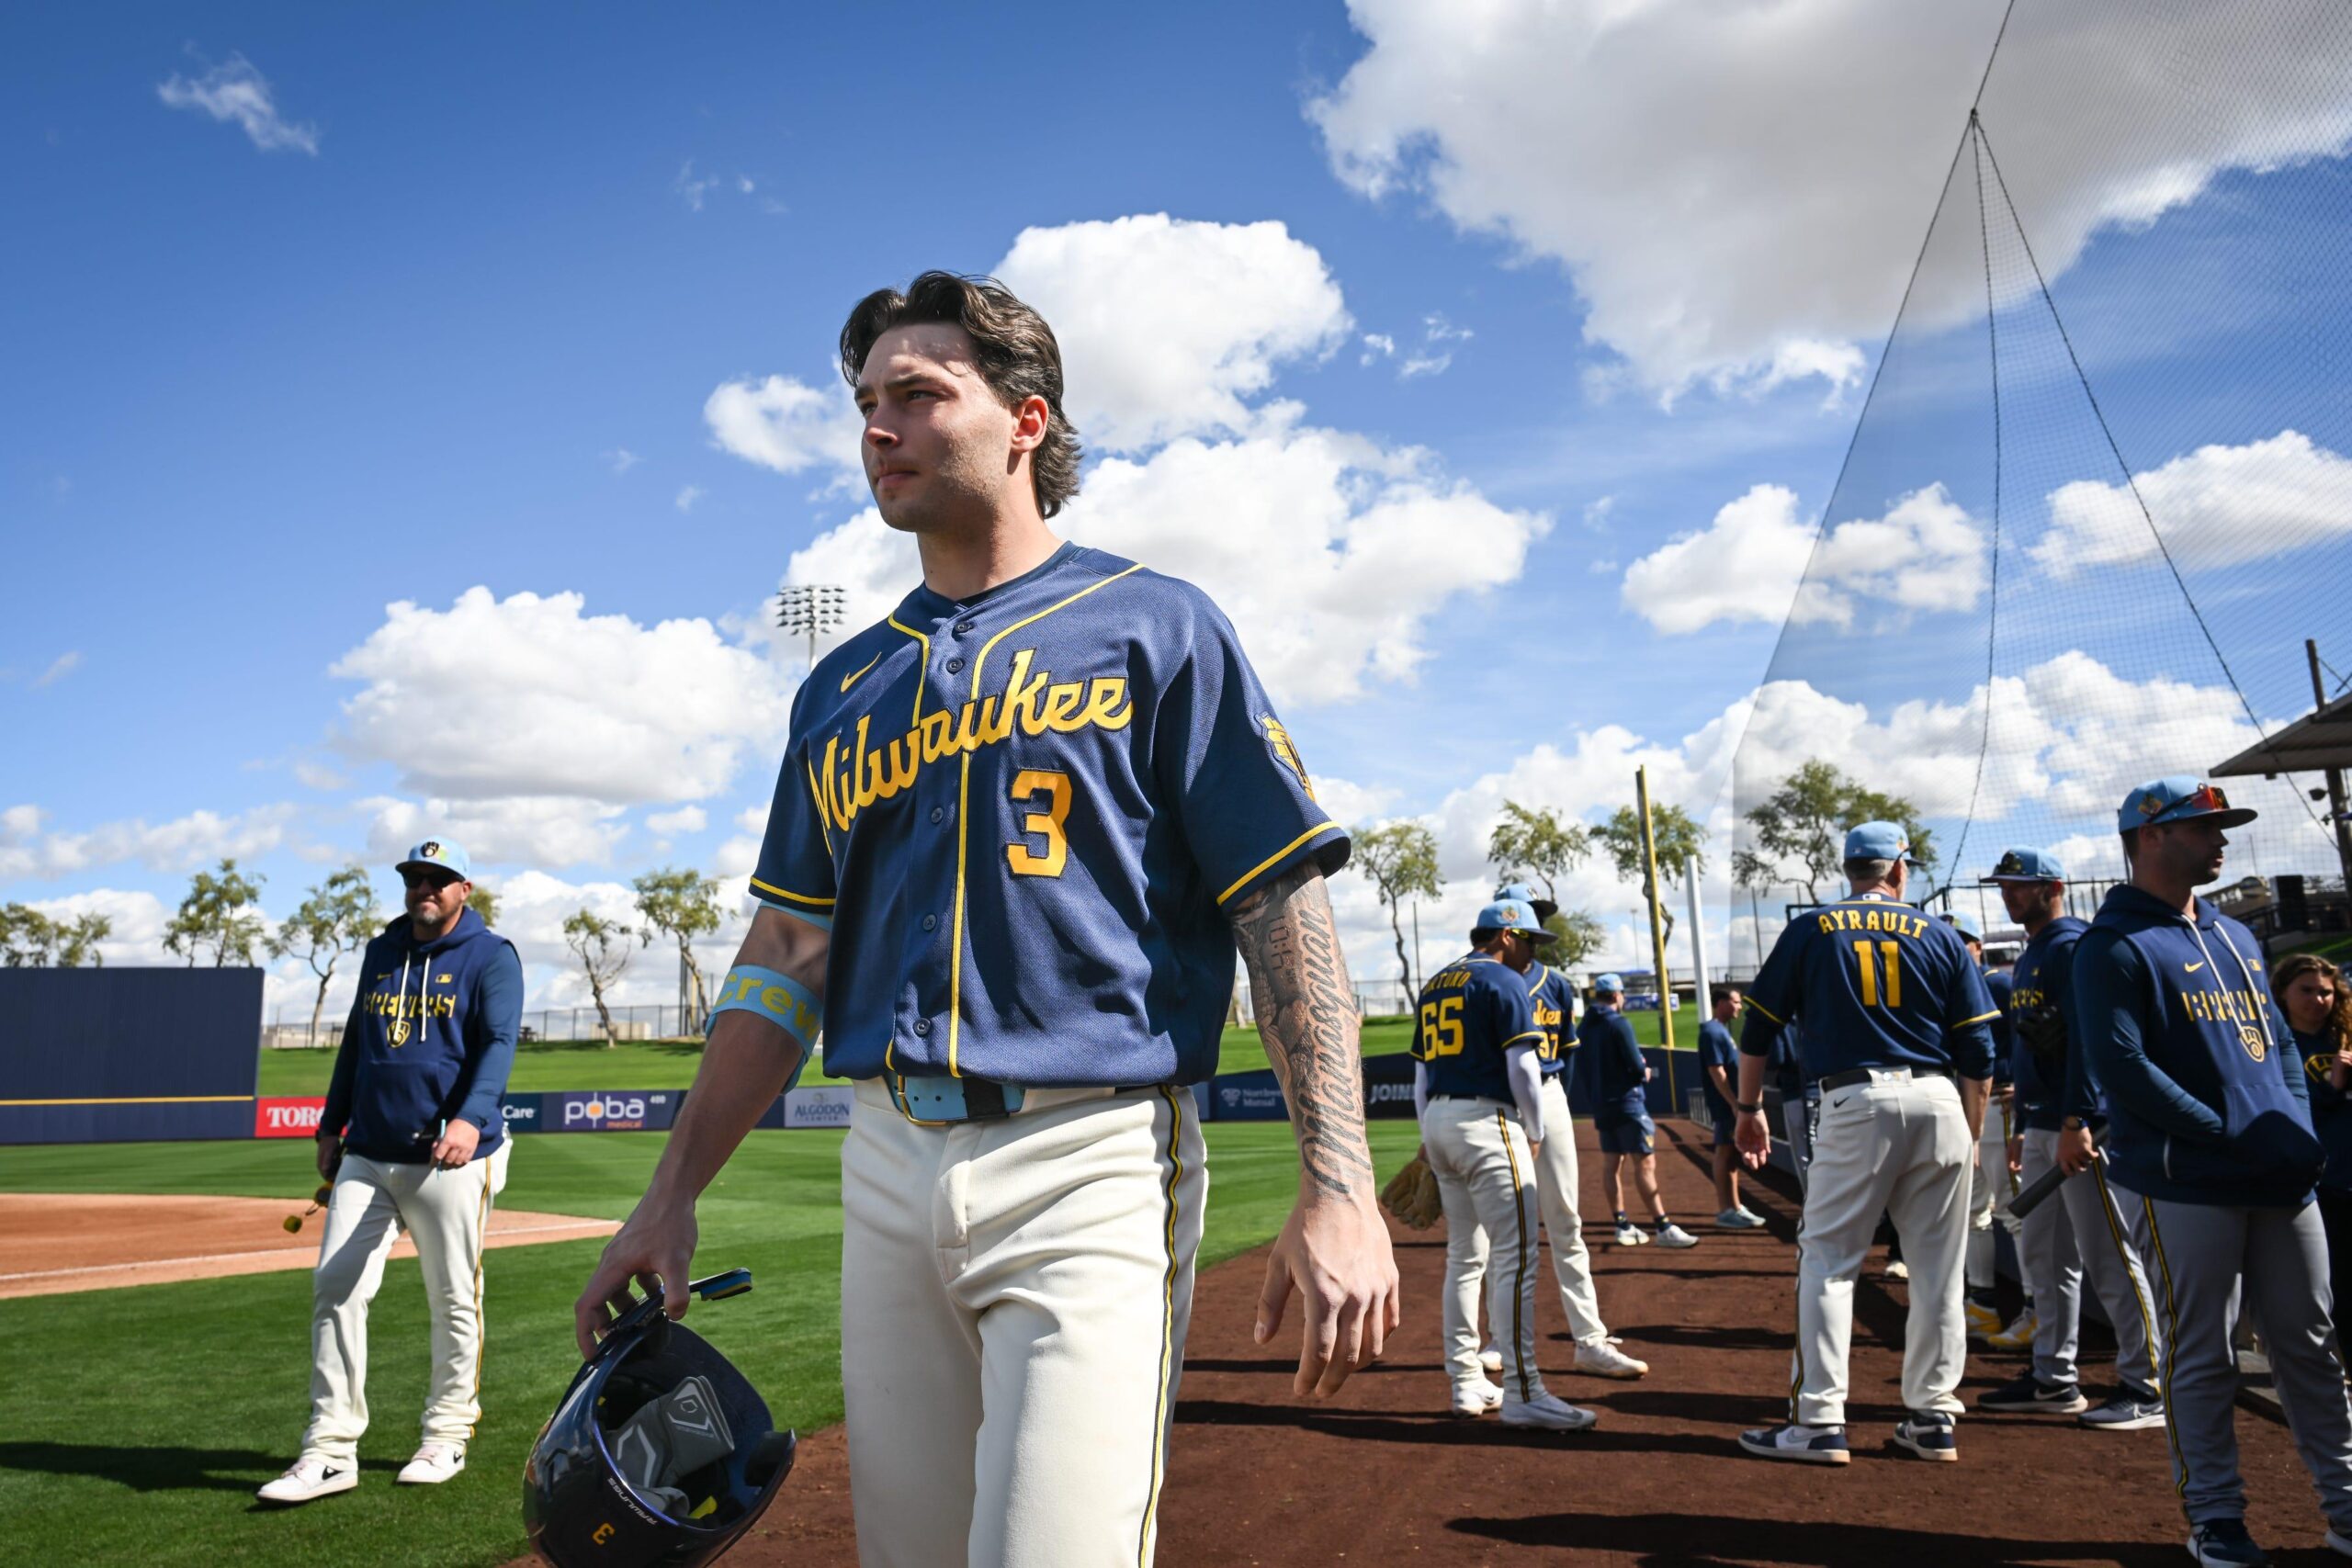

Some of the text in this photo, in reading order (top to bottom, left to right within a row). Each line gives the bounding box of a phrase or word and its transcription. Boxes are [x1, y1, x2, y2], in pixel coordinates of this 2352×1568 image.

[808, 648, 1134, 831] Milwaukee
[1006, 769, 1073, 878] 3
[1819, 909, 1928, 939] AYRAULT
[1853, 940, 1901, 1008] 11
[1421, 996, 1464, 1062] 65
[1370, 1084, 1416, 1104] JOIN
[502, 1104, 536, 1119] Care
[565, 1094, 645, 1126] poba
[795, 1102, 850, 1118] ALGODON
[592, 1522, 616, 1545] 3
